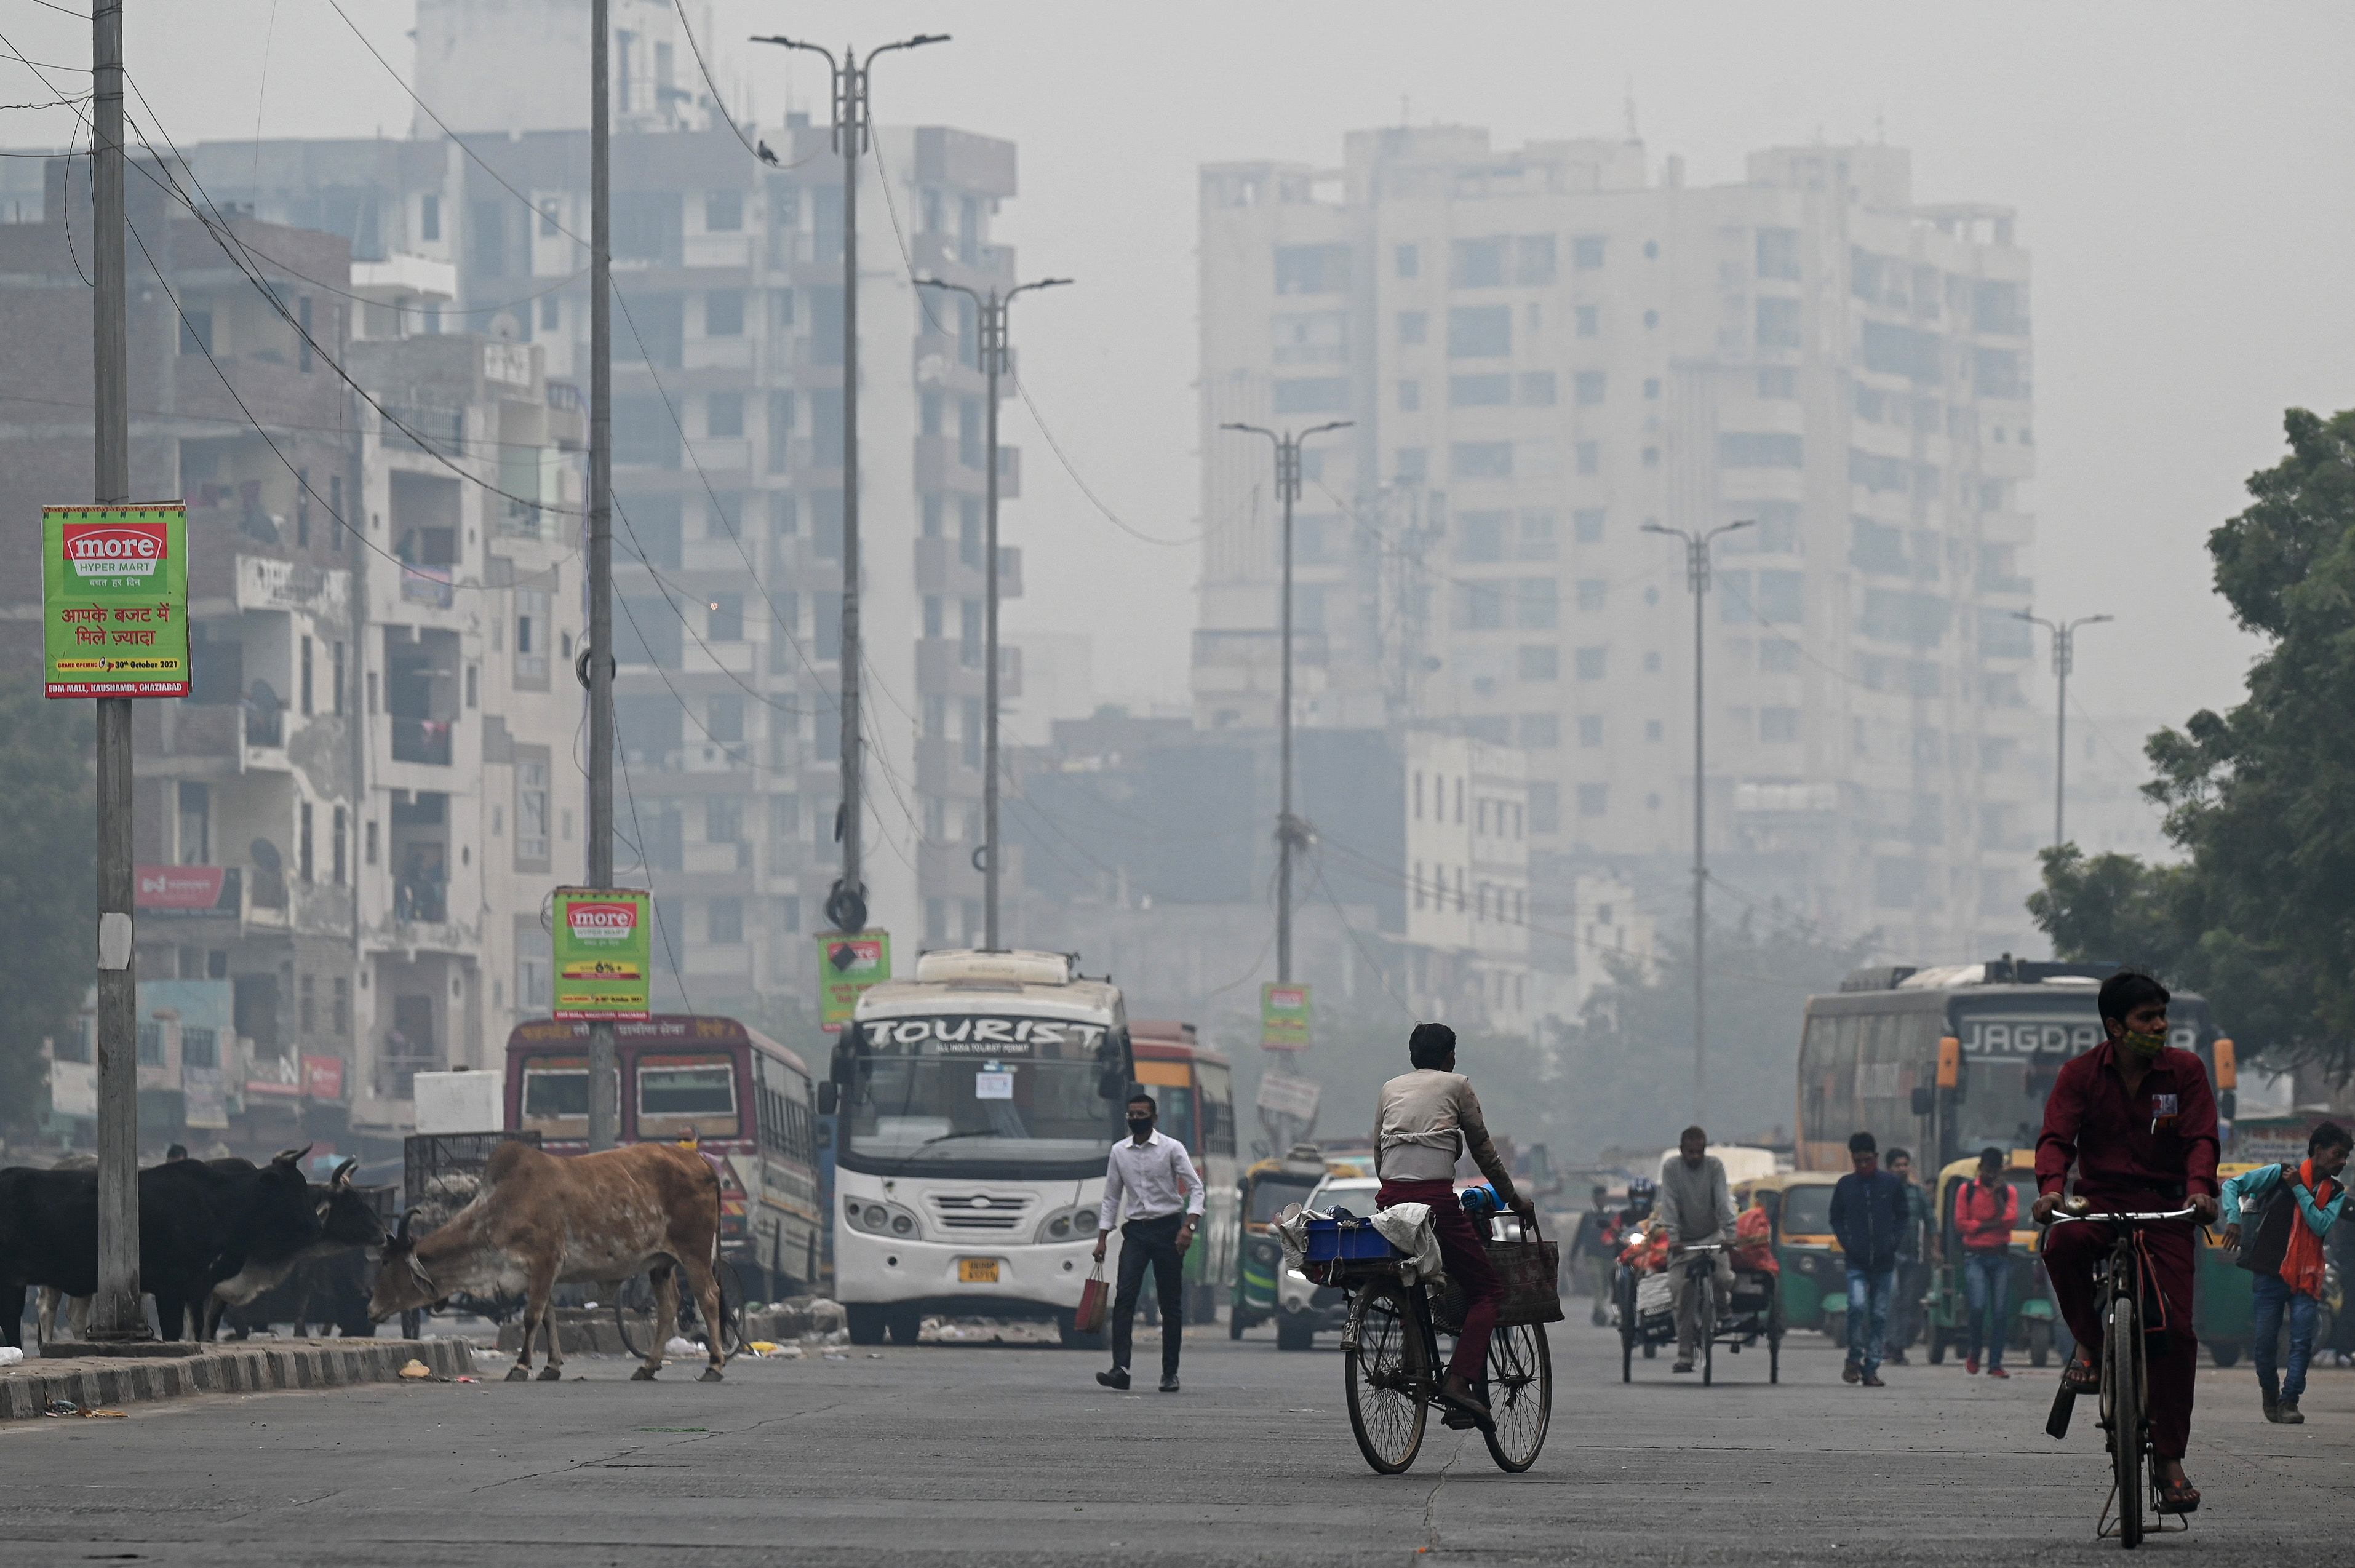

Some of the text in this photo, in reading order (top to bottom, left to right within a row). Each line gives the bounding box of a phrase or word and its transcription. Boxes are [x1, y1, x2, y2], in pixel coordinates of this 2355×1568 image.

[76, 539, 154, 557] more
[80, 562, 149, 571] HYPER MART
[127, 576, 140, 587] दिन
[62, 602, 170, 623] आपके बजट में
[75, 624, 156, 646] मिले ज़्यादा
[115, 660, 129, 669] 30th
[48, 683, 182, 694] EDM MALL, KAUSHAMBI, GHAZIABAD
[575, 912, 628, 926] more
[863, 1018, 1106, 1048] TOURIST
[950, 1043, 970, 1053] INDIA
